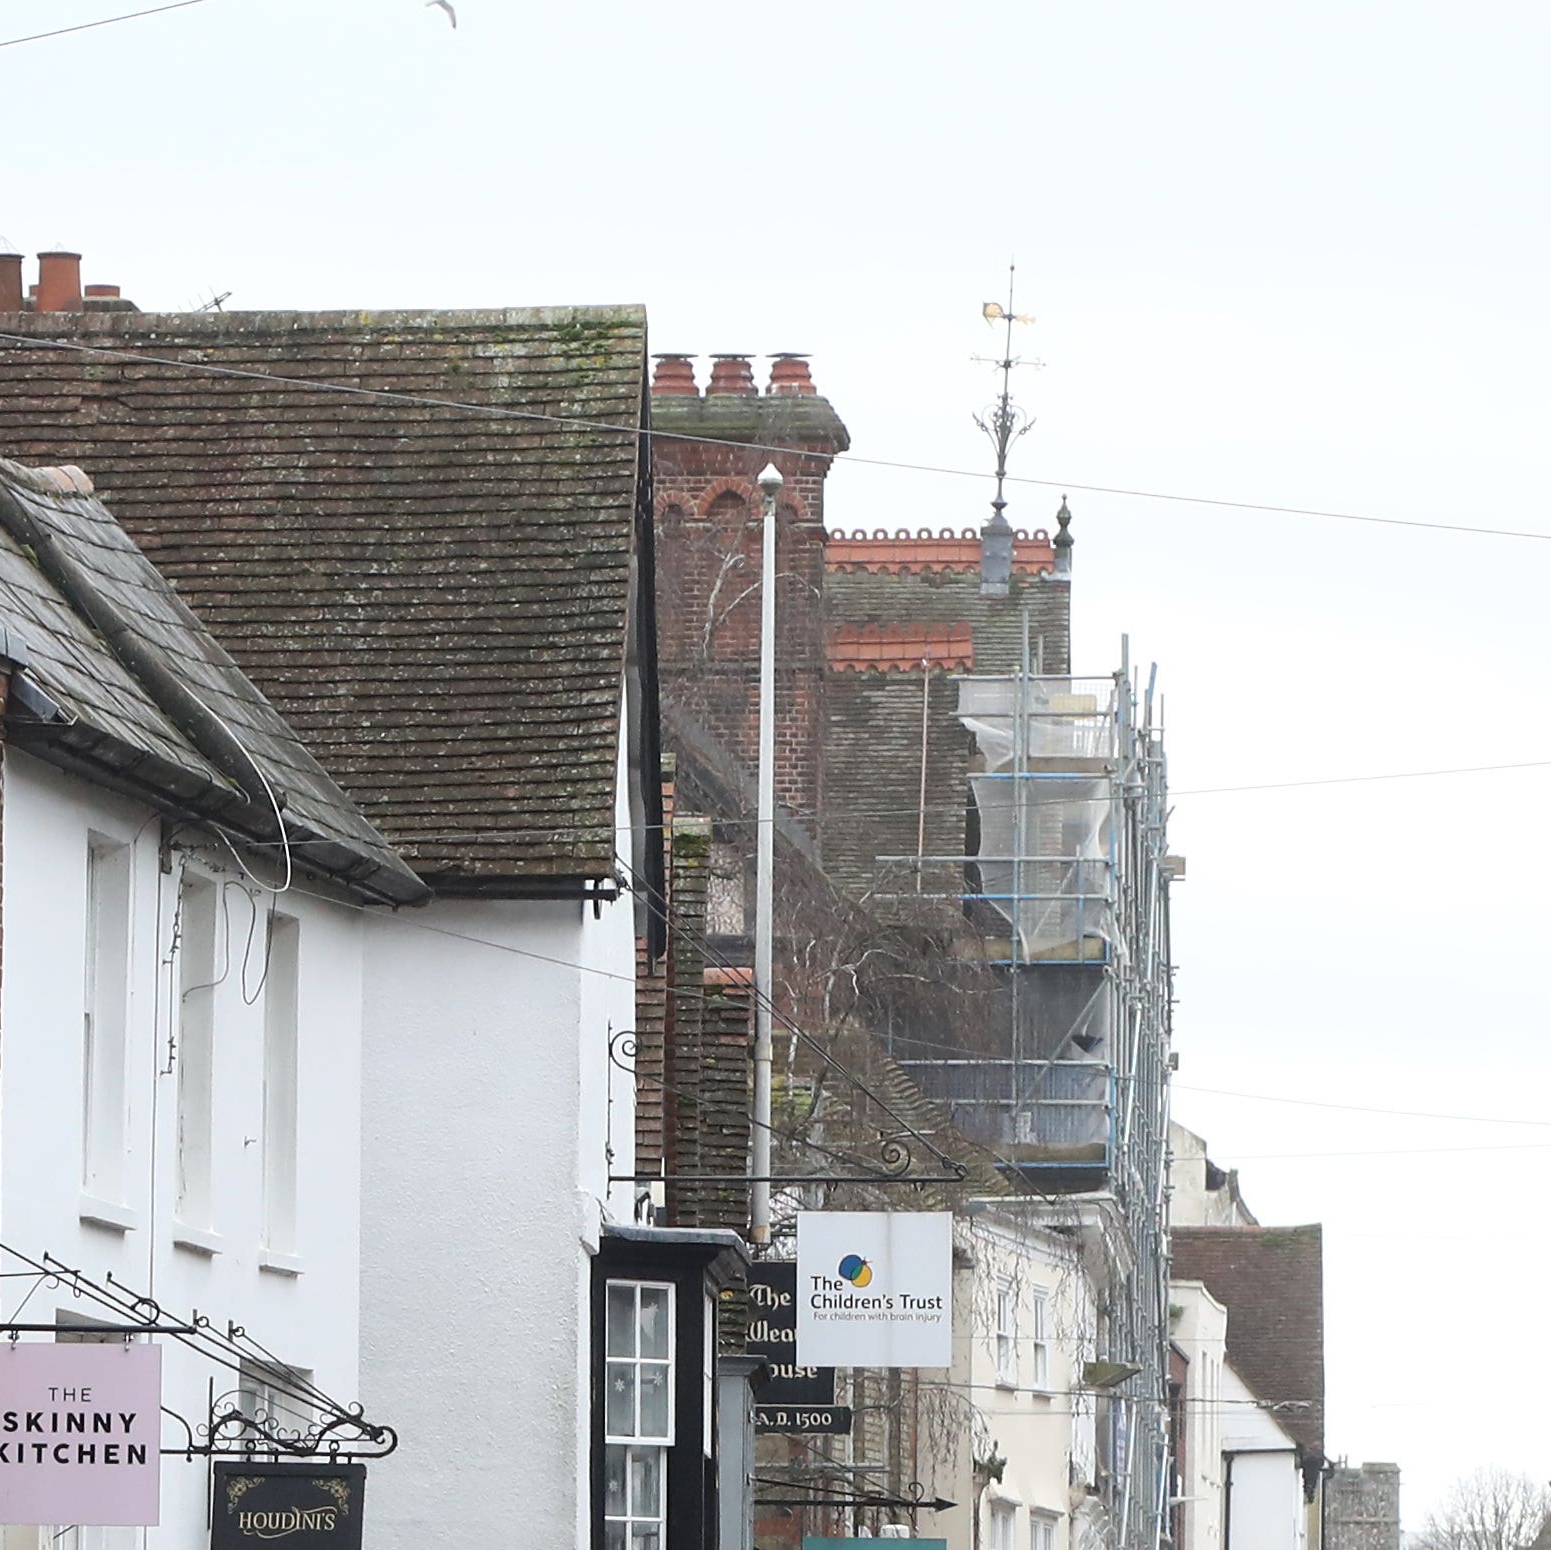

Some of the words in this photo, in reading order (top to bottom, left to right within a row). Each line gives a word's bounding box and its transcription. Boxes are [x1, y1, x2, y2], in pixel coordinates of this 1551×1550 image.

[811, 1276, 843, 1291] The
[750, 1284, 791, 1311] The
[811, 1294, 893, 1310] Children's
[899, 1294, 942, 1310] Trust
[48, 1386, 92, 1402] THE
[2, 1411, 137, 1434] SKINNY
[795, 1412, 832, 1429] 1500
[237, 1506, 336, 1538] HOUDINI'S
